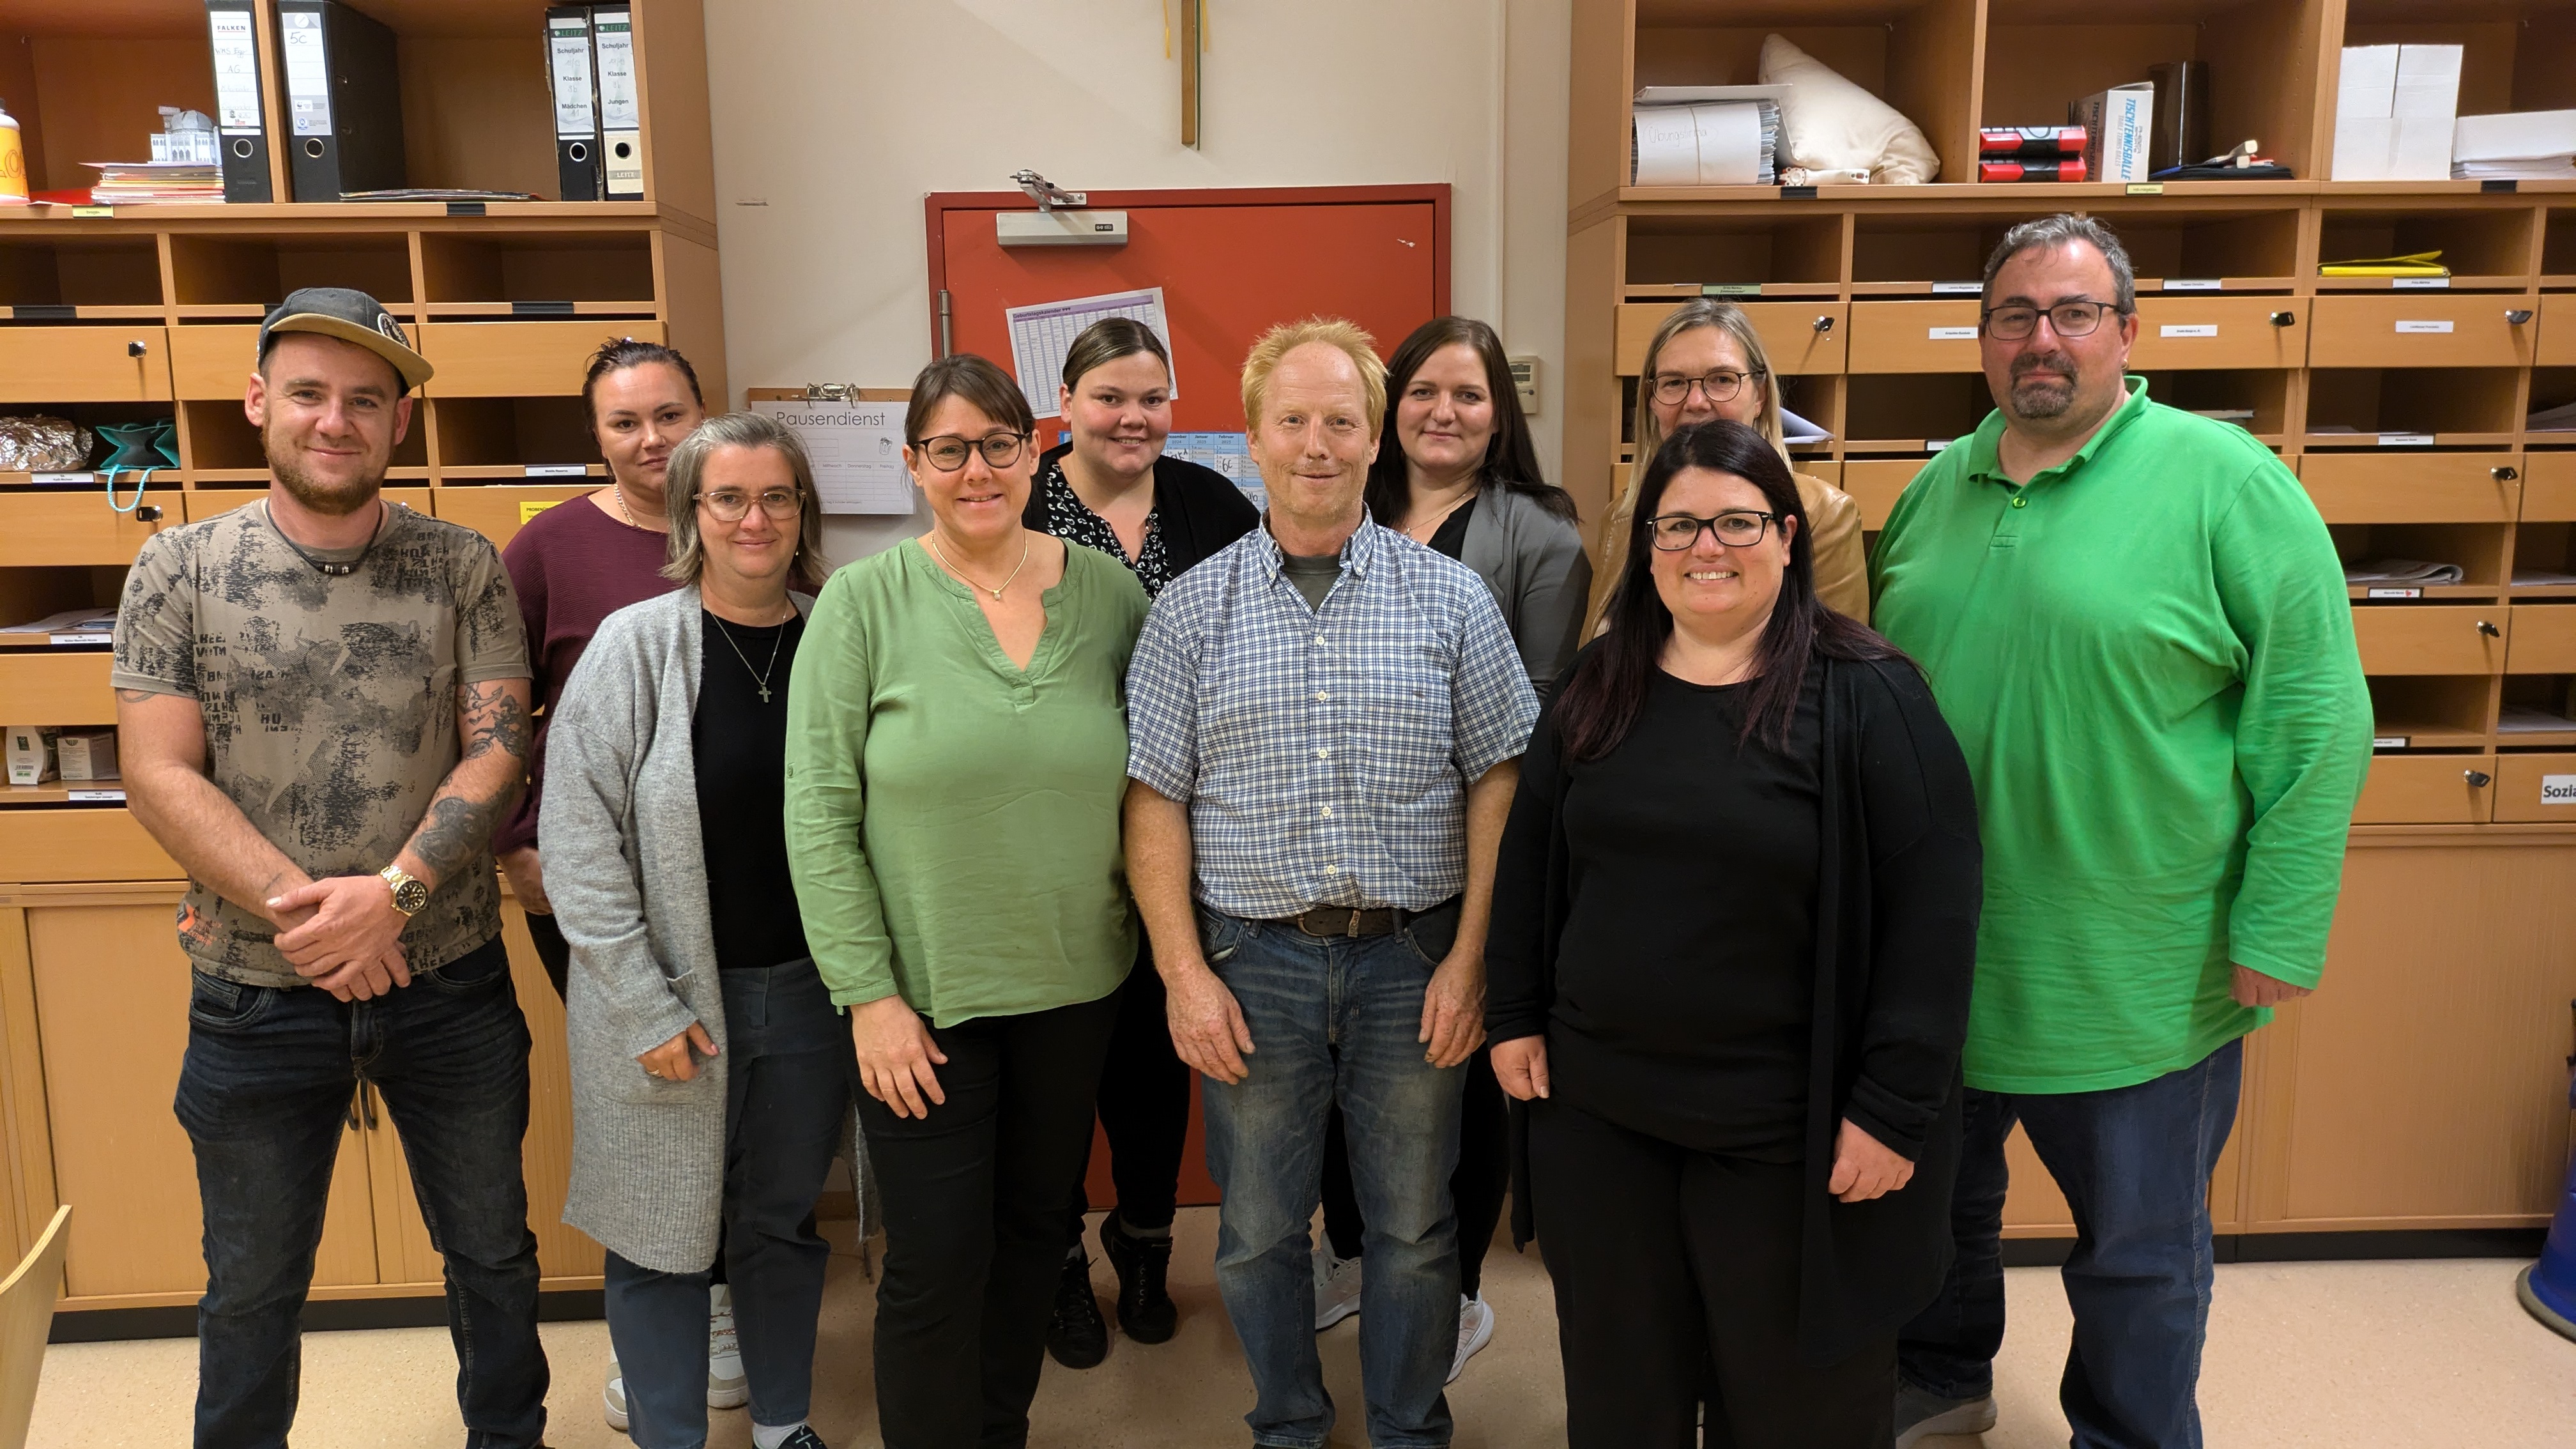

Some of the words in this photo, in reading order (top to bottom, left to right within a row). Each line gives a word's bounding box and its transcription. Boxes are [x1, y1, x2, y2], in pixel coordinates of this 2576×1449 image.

[227, 65, 241, 73] AG
[1013, 308, 1062, 319] Geburtstagskalender
[776, 411, 885, 426] Pausendienst
